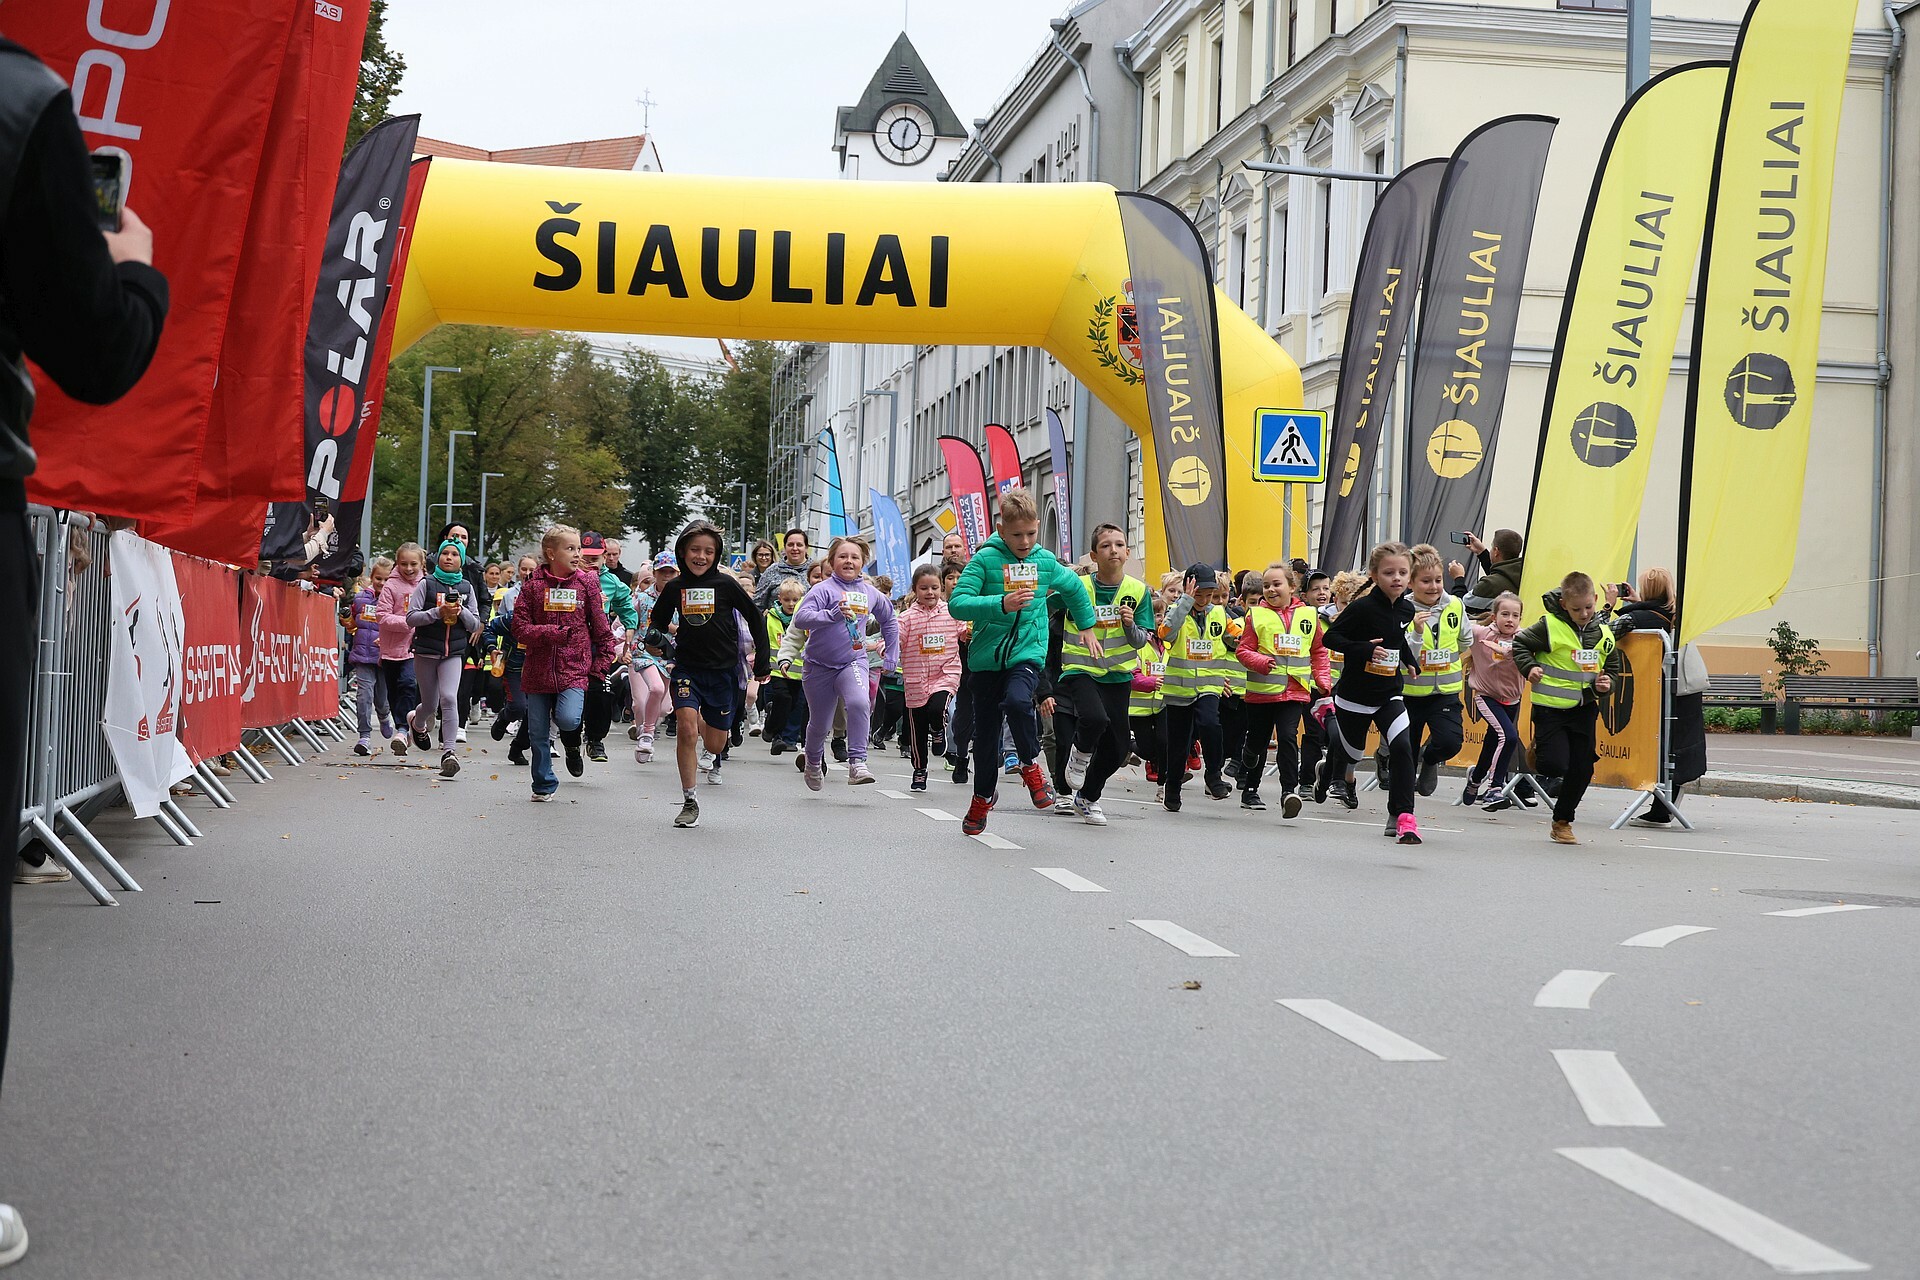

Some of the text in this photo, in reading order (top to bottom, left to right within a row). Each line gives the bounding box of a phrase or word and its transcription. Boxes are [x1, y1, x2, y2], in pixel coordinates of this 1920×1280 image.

[1741, 102, 1804, 333] ŠIAULIAI
[533, 200, 950, 308] ŠIAULIAI
[1593, 191, 1674, 388] ŠIAULIAI
[1442, 230, 1502, 406] ŠIAULIAI
[307, 211, 388, 499] POLAR
[1011, 565, 1037, 577] 1236
[551, 590, 575, 600] 1236
[687, 590, 713, 601] 1236
[848, 593, 867, 604] 1236
[1095, 607, 1120, 617] 1236
[924, 635, 944, 645] 1236
[1191, 641, 1211, 650] 1236
[1280, 635, 1300, 646] 1236
[1427, 650, 1449, 661] 1236
[1577, 652, 1598, 661] 1236
[1152, 664, 1165, 673] 123
[1600, 740, 1630, 760] ŠIAULIAI
